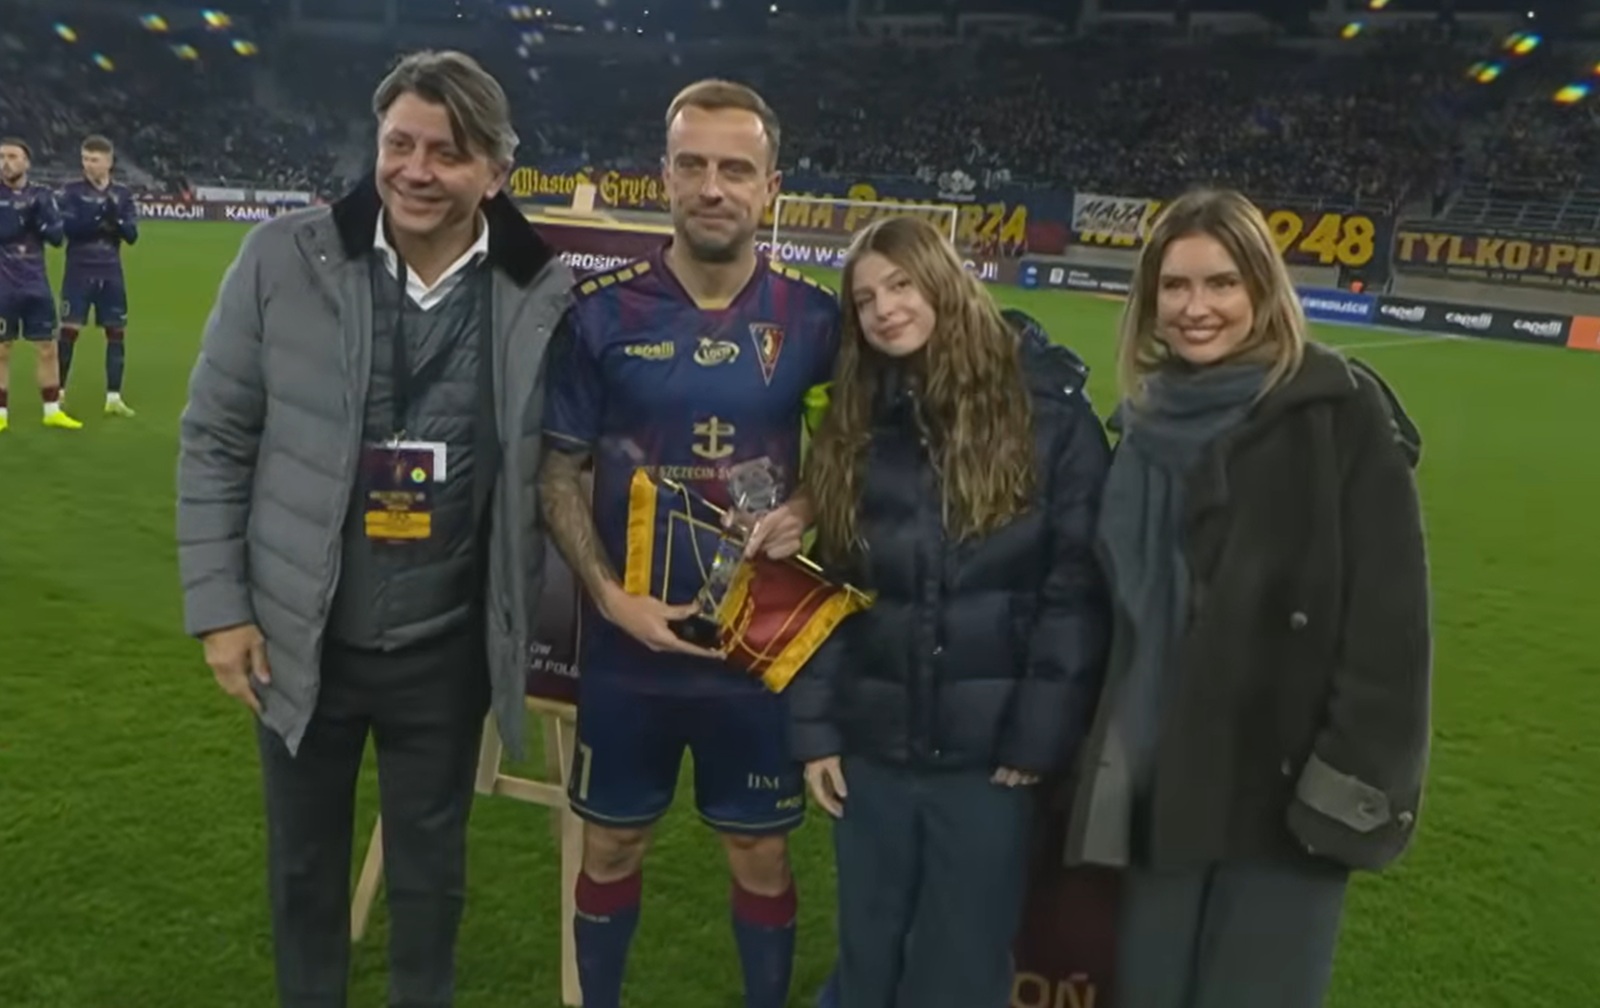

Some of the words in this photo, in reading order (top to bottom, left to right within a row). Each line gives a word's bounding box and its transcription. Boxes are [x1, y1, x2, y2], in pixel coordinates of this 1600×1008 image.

[1398, 232, 1532, 271] TYLKO
[1445, 312, 1493, 330] capelli
[1513, 319, 1562, 337] capelli
